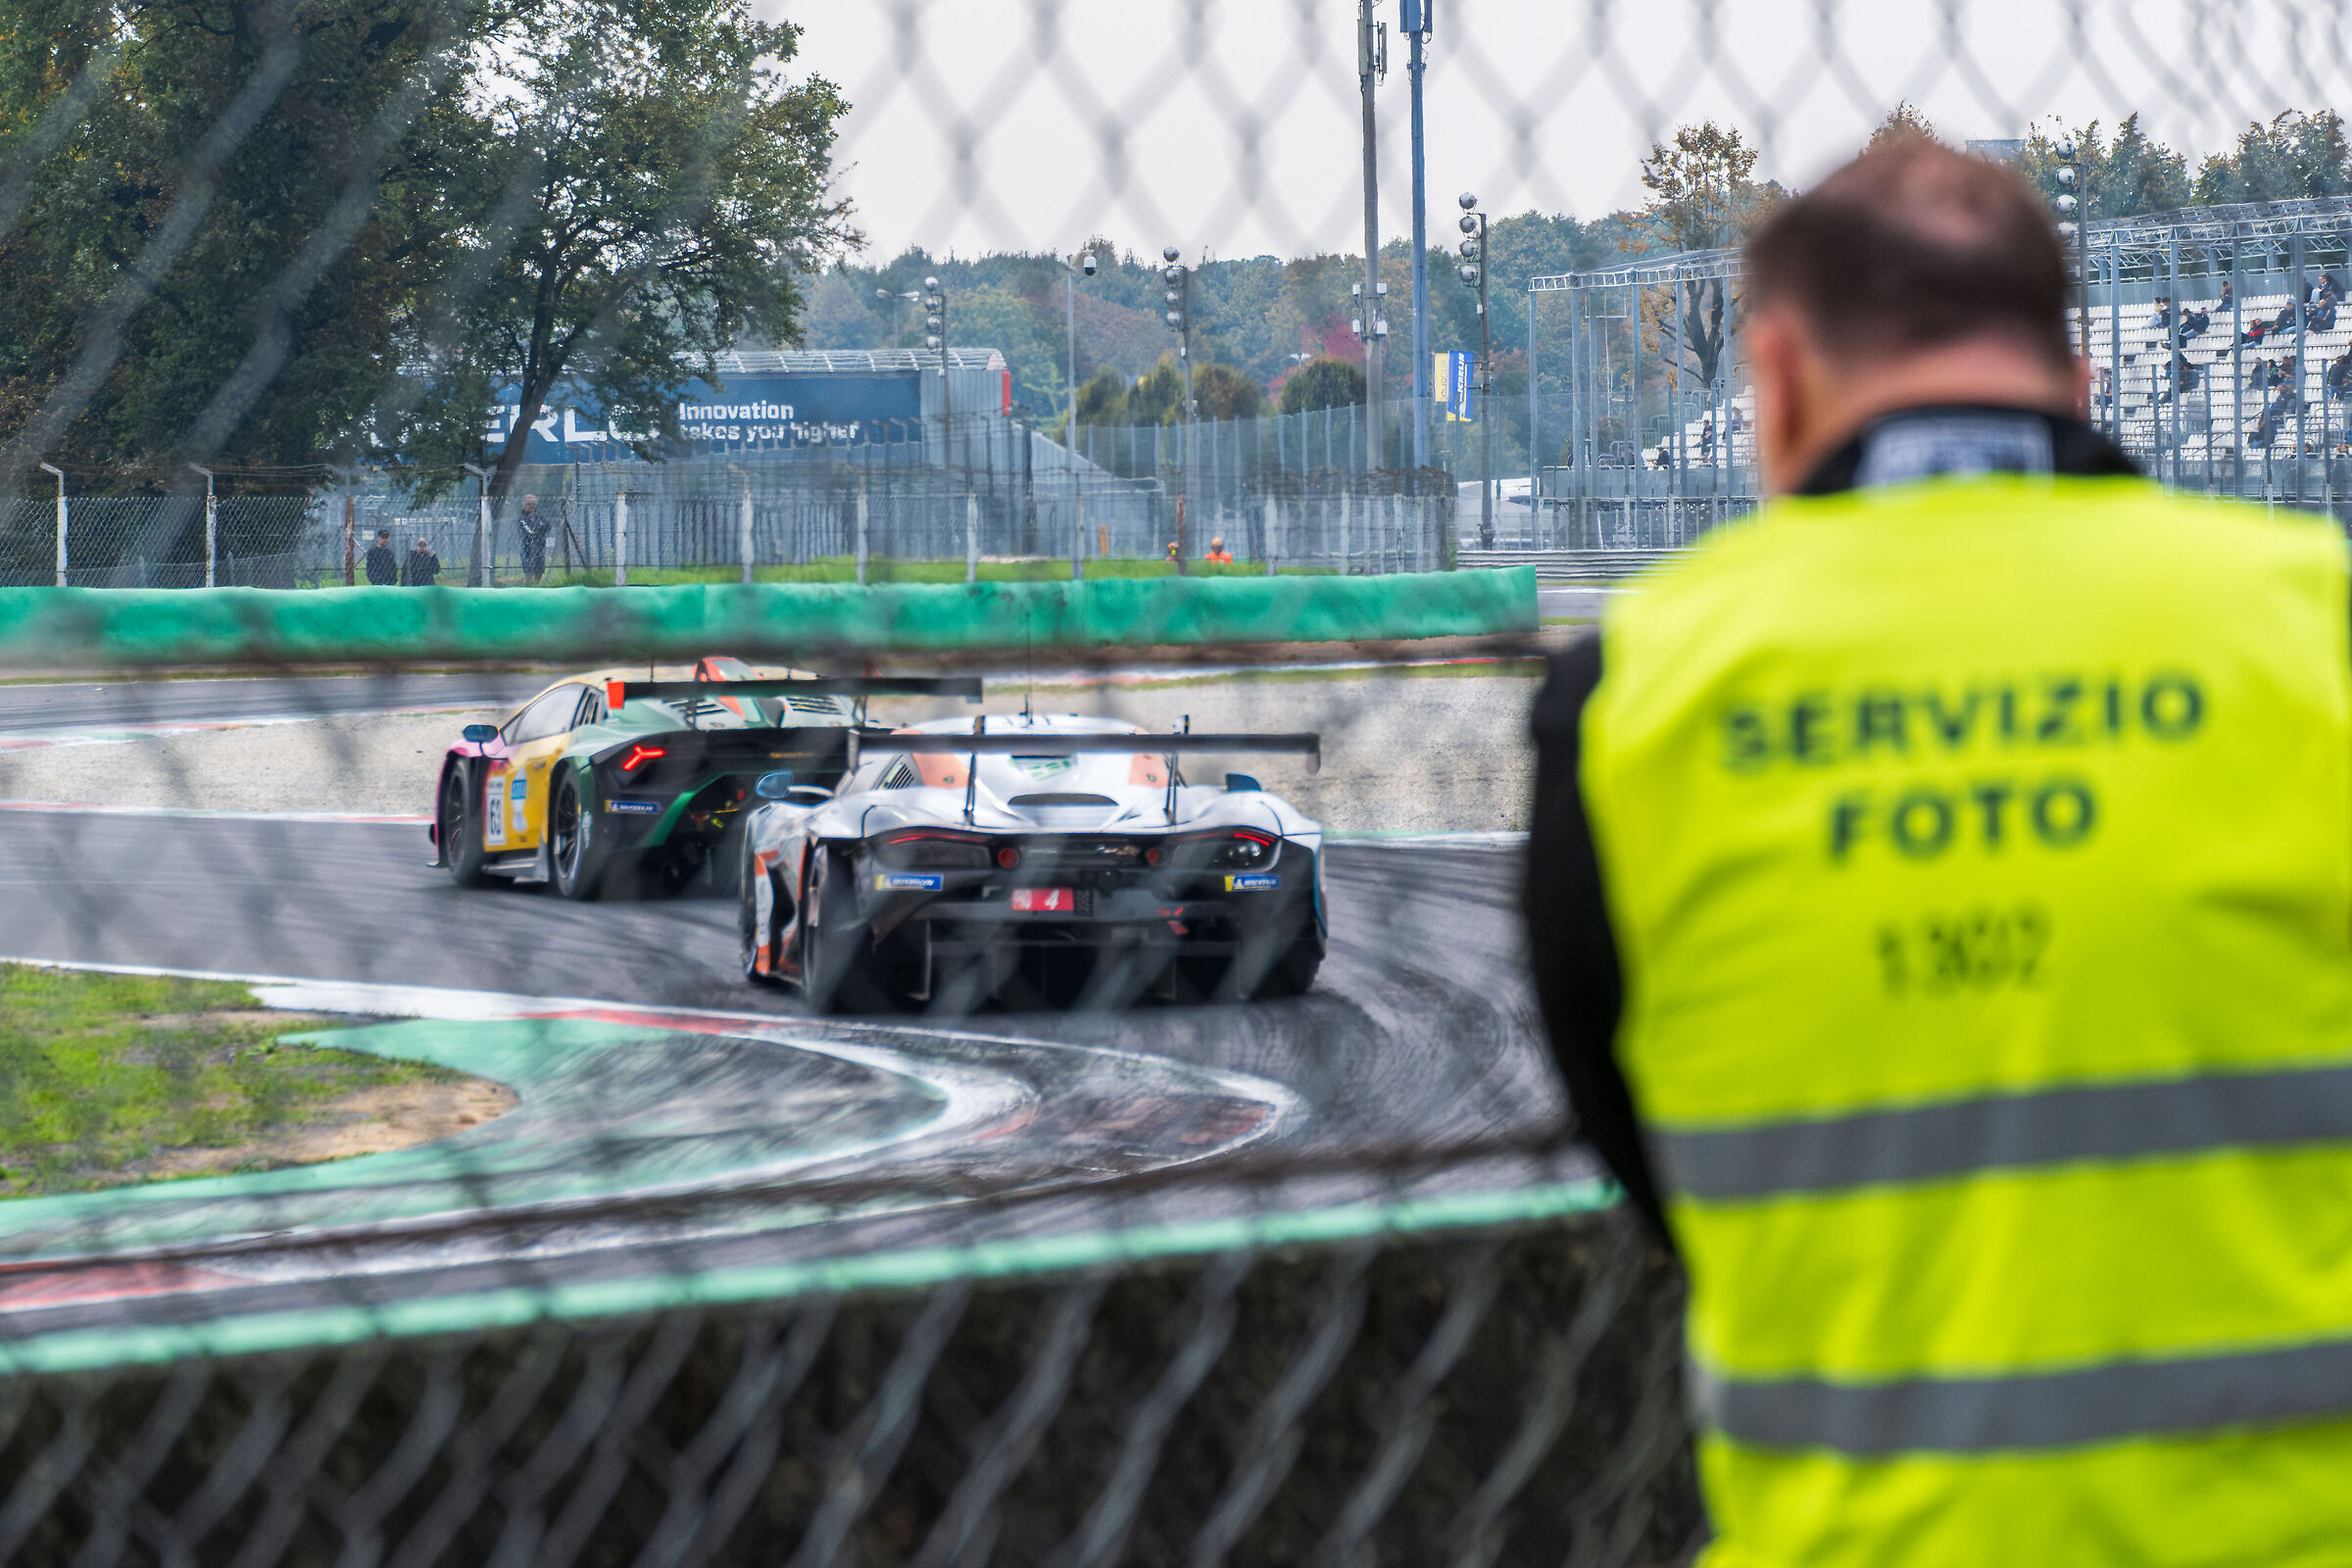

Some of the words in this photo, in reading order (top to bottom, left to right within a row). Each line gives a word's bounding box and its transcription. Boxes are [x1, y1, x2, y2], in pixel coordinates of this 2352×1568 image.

[679, 400, 794, 420] Innovation
[746, 425, 784, 442] you
[790, 421, 859, 443] higher
[1723, 674, 2203, 776] SERVIZIO
[1828, 777, 2098, 866] FOTO
[1044, 888, 1059, 910] 4
